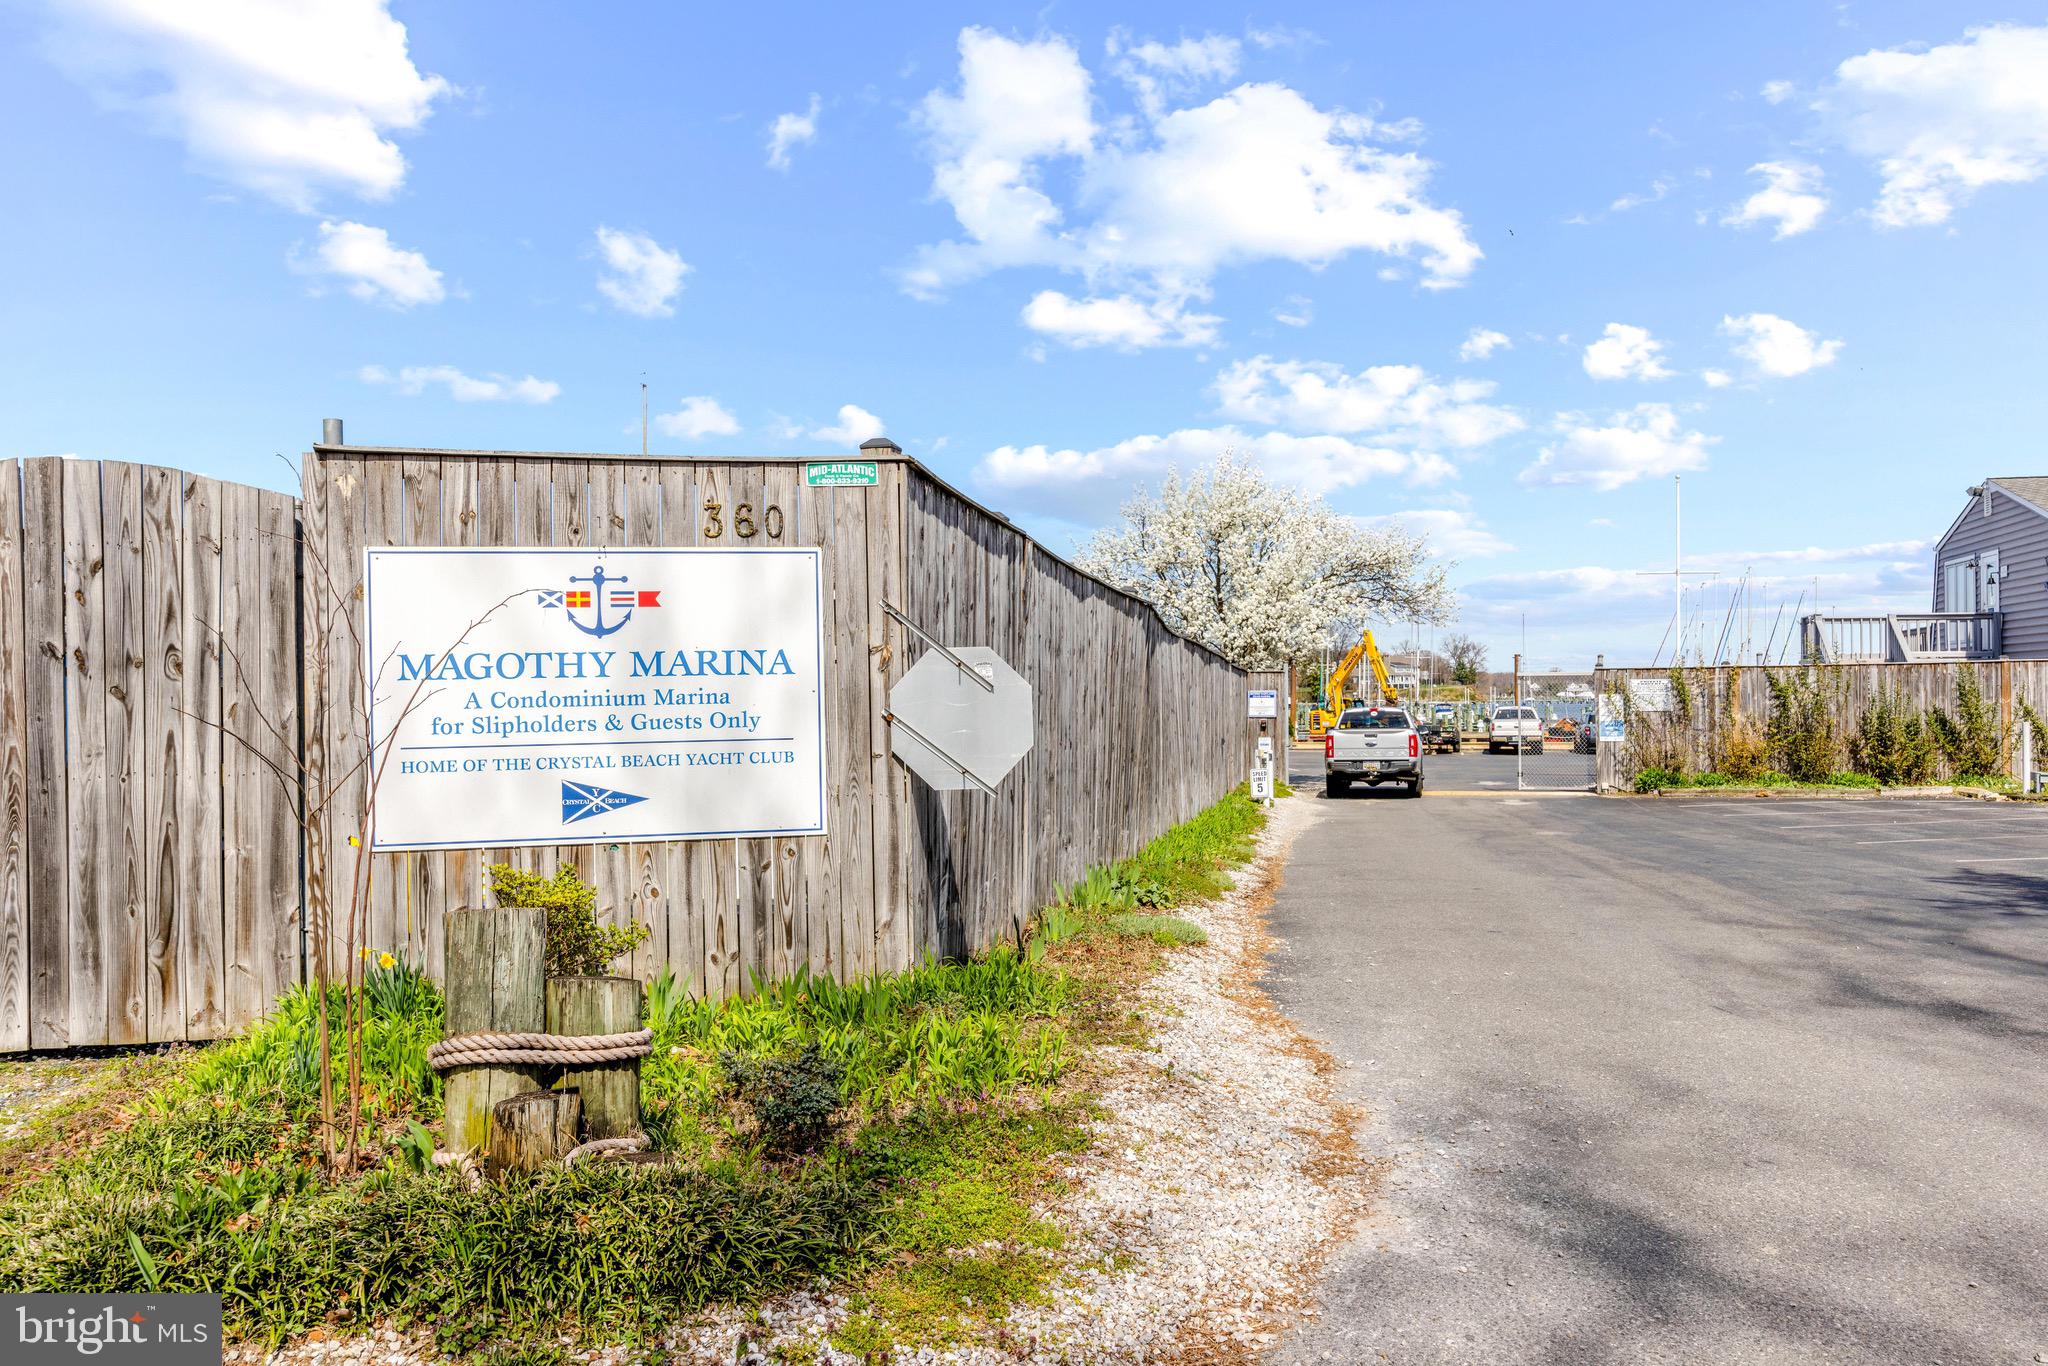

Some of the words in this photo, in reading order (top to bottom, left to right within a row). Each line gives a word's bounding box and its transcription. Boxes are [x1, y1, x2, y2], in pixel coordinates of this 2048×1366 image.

[809, 464, 875, 477] MID-ATLANTIC
[704, 503, 783, 538] 360
[397, 652, 616, 681] MAGOTHY
[629, 649, 796, 677] MARINA
[464, 692, 482, 709] A
[490, 688, 646, 709] Condominium
[654, 687, 731, 706] Marina
[431, 717, 464, 735] for
[472, 714, 597, 738] Slipholders
[605, 713, 624, 731] &
[631, 711, 702, 731] Guests
[709, 710, 761, 732] Only
[401, 760, 458, 774] HOME
[463, 759, 486, 773] OF
[492, 758, 531, 772] THE
[536, 755, 616, 771] CRYSTAL
[621, 753, 680, 768] BEACH
[686, 752, 745, 766] YACHT
[750, 751, 795, 764] CLUB
[1257, 783, 1264, 793] 5
